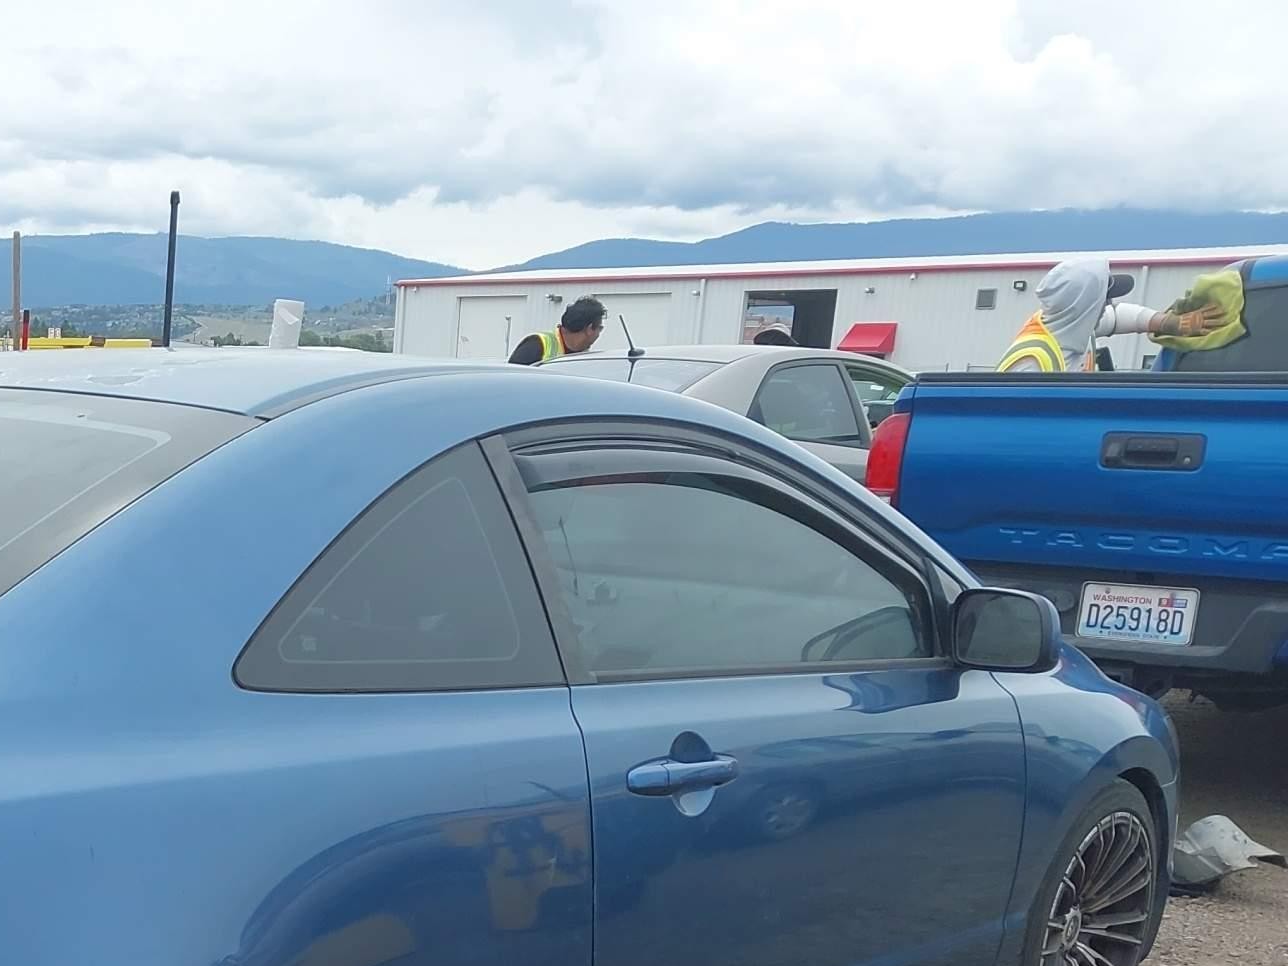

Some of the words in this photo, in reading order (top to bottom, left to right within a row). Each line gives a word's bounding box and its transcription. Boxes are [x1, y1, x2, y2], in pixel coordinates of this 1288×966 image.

[999, 525, 1288, 561] TACOMA
[1093, 593, 1152, 605] WASHINGTON
[1086, 603, 1184, 636] D25918D
